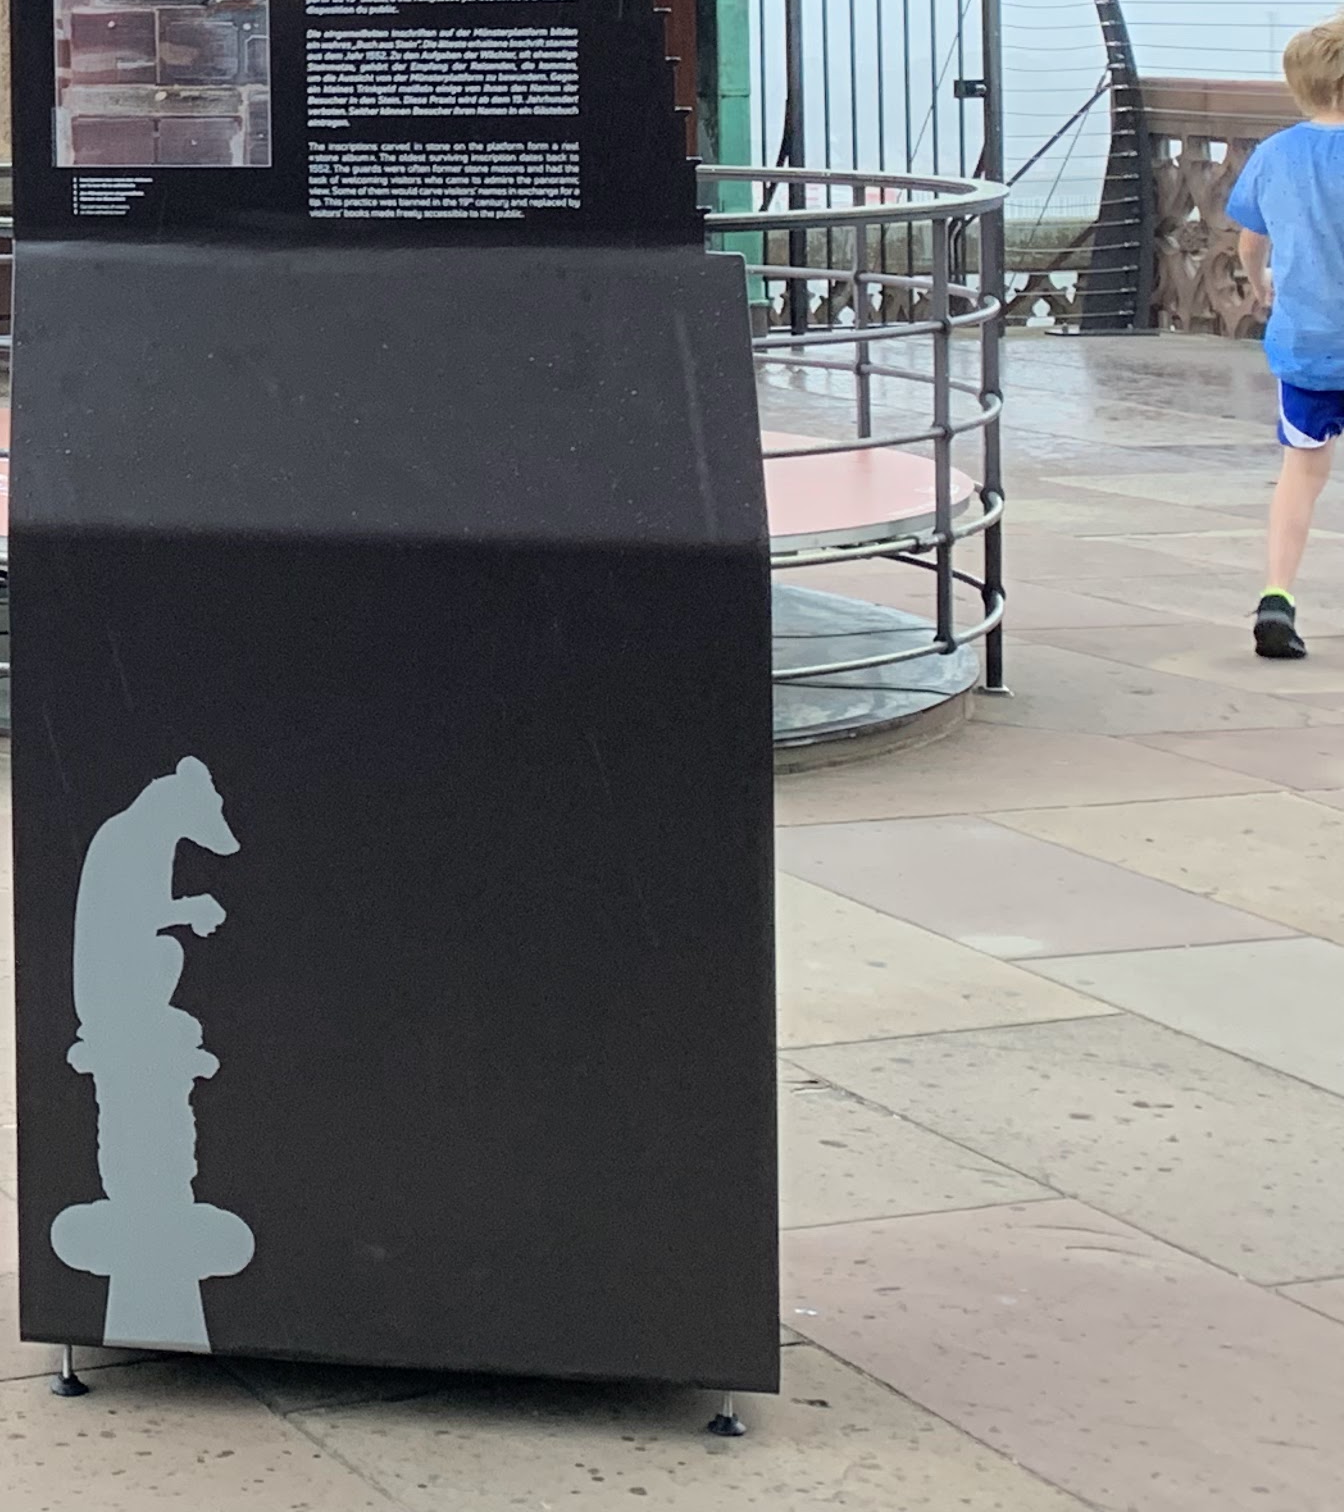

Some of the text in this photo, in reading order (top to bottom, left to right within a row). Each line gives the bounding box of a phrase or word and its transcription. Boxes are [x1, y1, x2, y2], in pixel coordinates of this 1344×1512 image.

[309, 142, 326, 151] The
[328, 143, 378, 152] inscriptions
[381, 143, 411, 151] carved
[468, 142, 484, 151] the
[486, 142, 524, 152] platform
[527, 142, 549, 150] form
[561, 142, 580, 150] real
[380, 153, 580, 164] The oldest surviving inscription dates back to
[334, 164, 350, 173] The
[352, 165, 382, 175] guards
[408, 165, 431, 173] often
[432, 165, 462, 173] former
[527, 165, 544, 173] and
[546, 165, 563, 173] had
[565, 165, 580, 173] the
[308, 176, 327, 184] task
[330, 176, 339, 184] of
[342, 177, 388, 186] welcoming
[425, 176, 444, 184] who
[484, 176, 514, 184] admire
[516, 176, 532, 184] the
[534, 177, 580, 185] panoramic
[332, 186, 357, 195] Some
[358, 187, 366, 195] of
[368, 187, 390, 195] them
[391, 187, 418, 195] would
[518, 188, 559, 197] exchange
[560, 187, 572, 195] for
[574, 188, 580, 196] a
[325, 197, 342, 206] This
[344, 199, 378, 207] practice
[475, 199, 510, 208] century
[511, 198, 528, 207] and
[529, 198, 567, 208] replaced
[568, 199, 581, 208] by
[344, 210, 370, 218] books
[371, 210, 395, 218] made
[396, 209, 423, 219] freely
[469, 210, 479, 218] to
[480, 210, 495, 218] the
